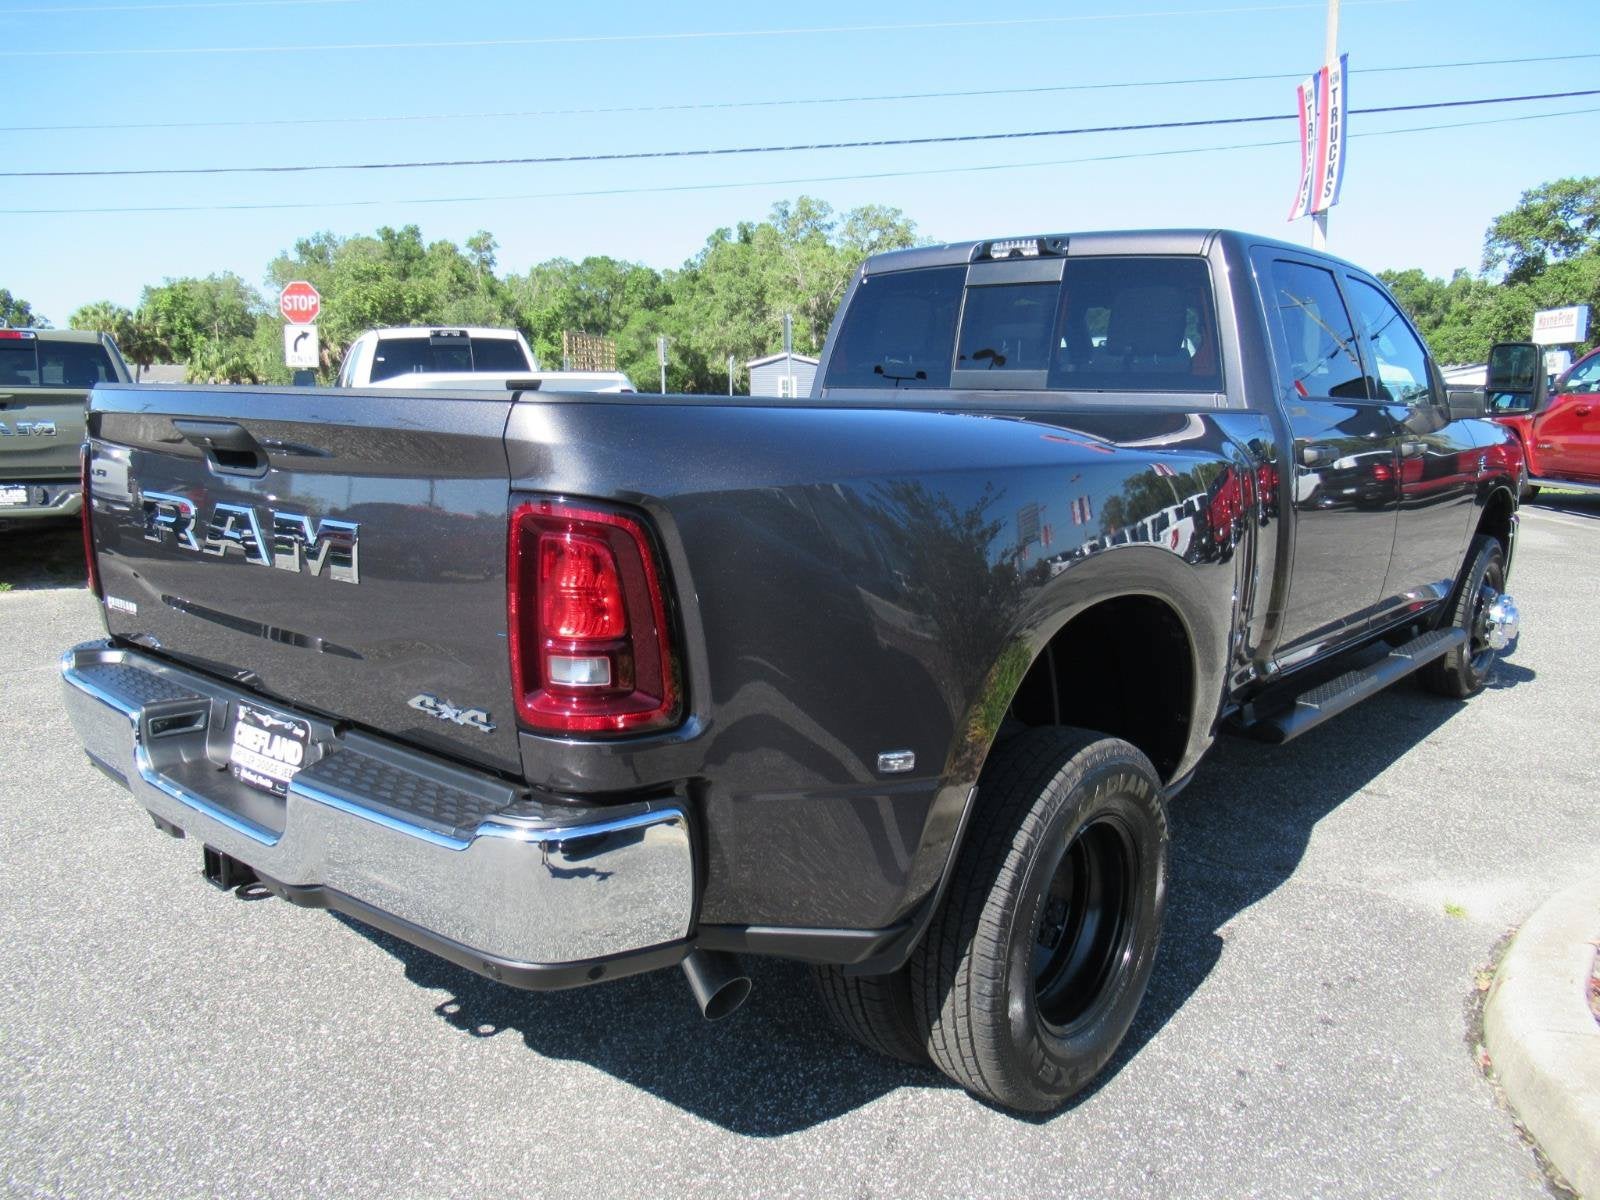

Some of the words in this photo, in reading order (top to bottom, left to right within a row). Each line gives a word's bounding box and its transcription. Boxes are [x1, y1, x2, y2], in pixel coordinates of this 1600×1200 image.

[1323, 87, 1339, 198] TRUCKS
[283, 294, 317, 311] STOP
[143, 490, 361, 584] RAM
